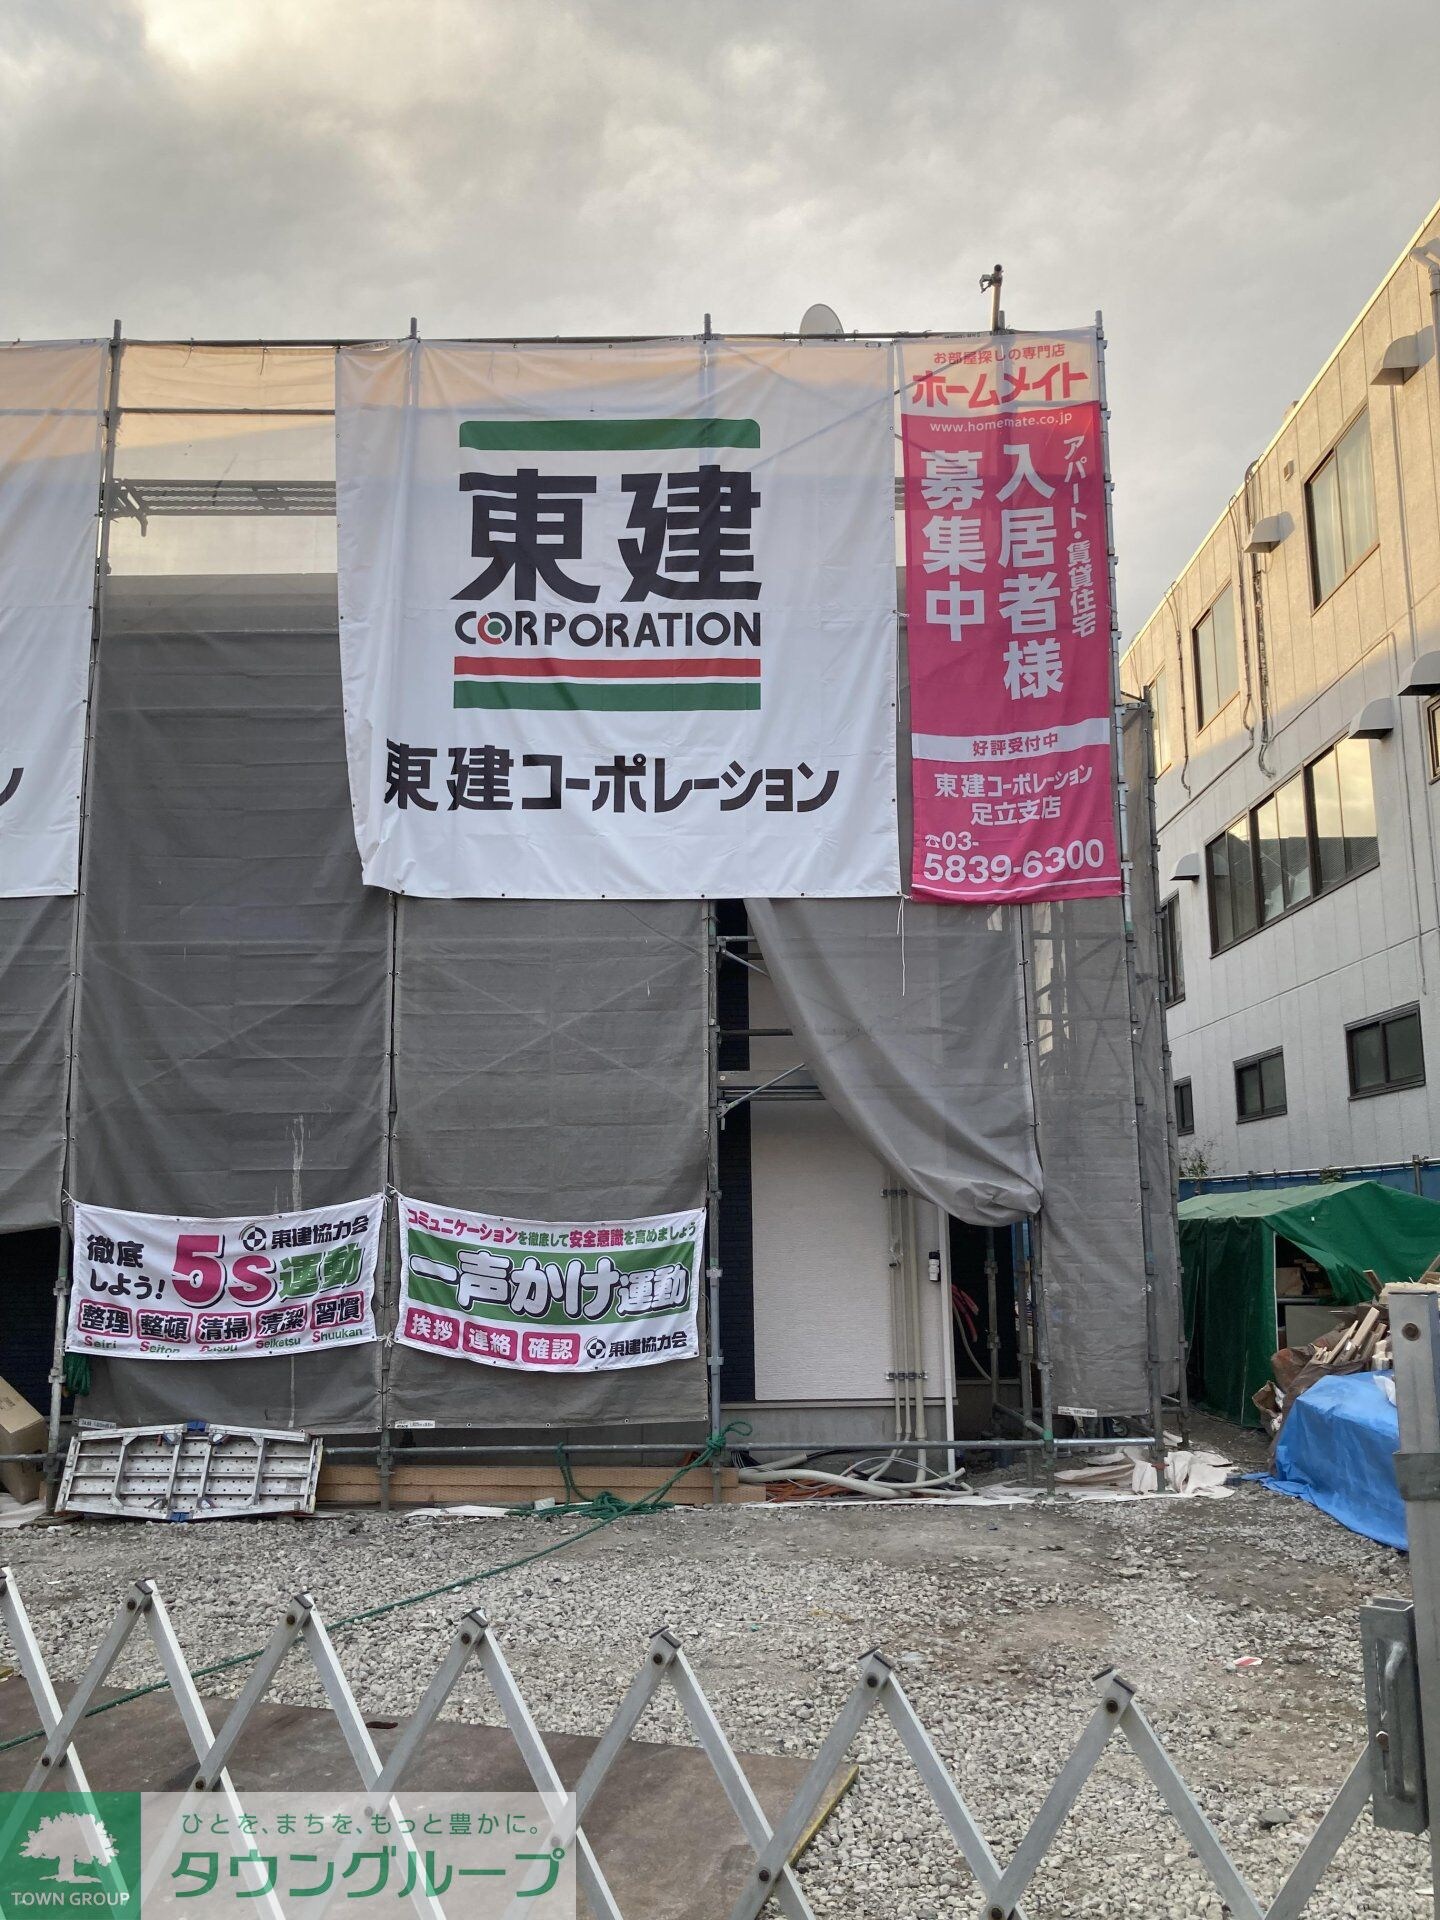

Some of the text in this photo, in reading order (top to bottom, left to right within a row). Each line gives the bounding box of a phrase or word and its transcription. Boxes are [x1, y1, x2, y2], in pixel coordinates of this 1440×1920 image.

[934, 343, 1066, 365] お部屋探しの専門店
[912, 361, 1088, 408] ホームメイト
[930, 411, 1073, 433] www.homemate.co.jp
[450, 464, 762, 603] 東建
[920, 450, 987, 642] 募集中
[1063, 435, 1096, 638] アパート・賃貸住宅
[996, 443, 1064, 700] 入居者様
[454, 610, 761, 647] CORPORATION
[973, 732, 1058, 756] 好評受付中
[384, 738, 839, 813] 東建コーポレーション
[934, 764, 1092, 798] 東建コーポレーション
[971, 795, 1061, 826] 足立支店
[923, 838, 1105, 884] 5839-6300
[86, 1233, 145, 1269] 徹底
[271, 1214, 369, 1251] 東建協力会
[410, 1250, 691, 1320] 一声かけ運動
[80, 1296, 362, 1342] 整理 整頓 清掃 清潔 習慣
[84, 1335, 117, 1349] Seiri
[256, 1335, 301, 1349] Seiketsu
[312, 1328, 363, 1343] Shuukan
[411, 1313, 573, 1361] 挨拶 連絡 確認
[608, 1331, 688, 1358] 東建協力会
